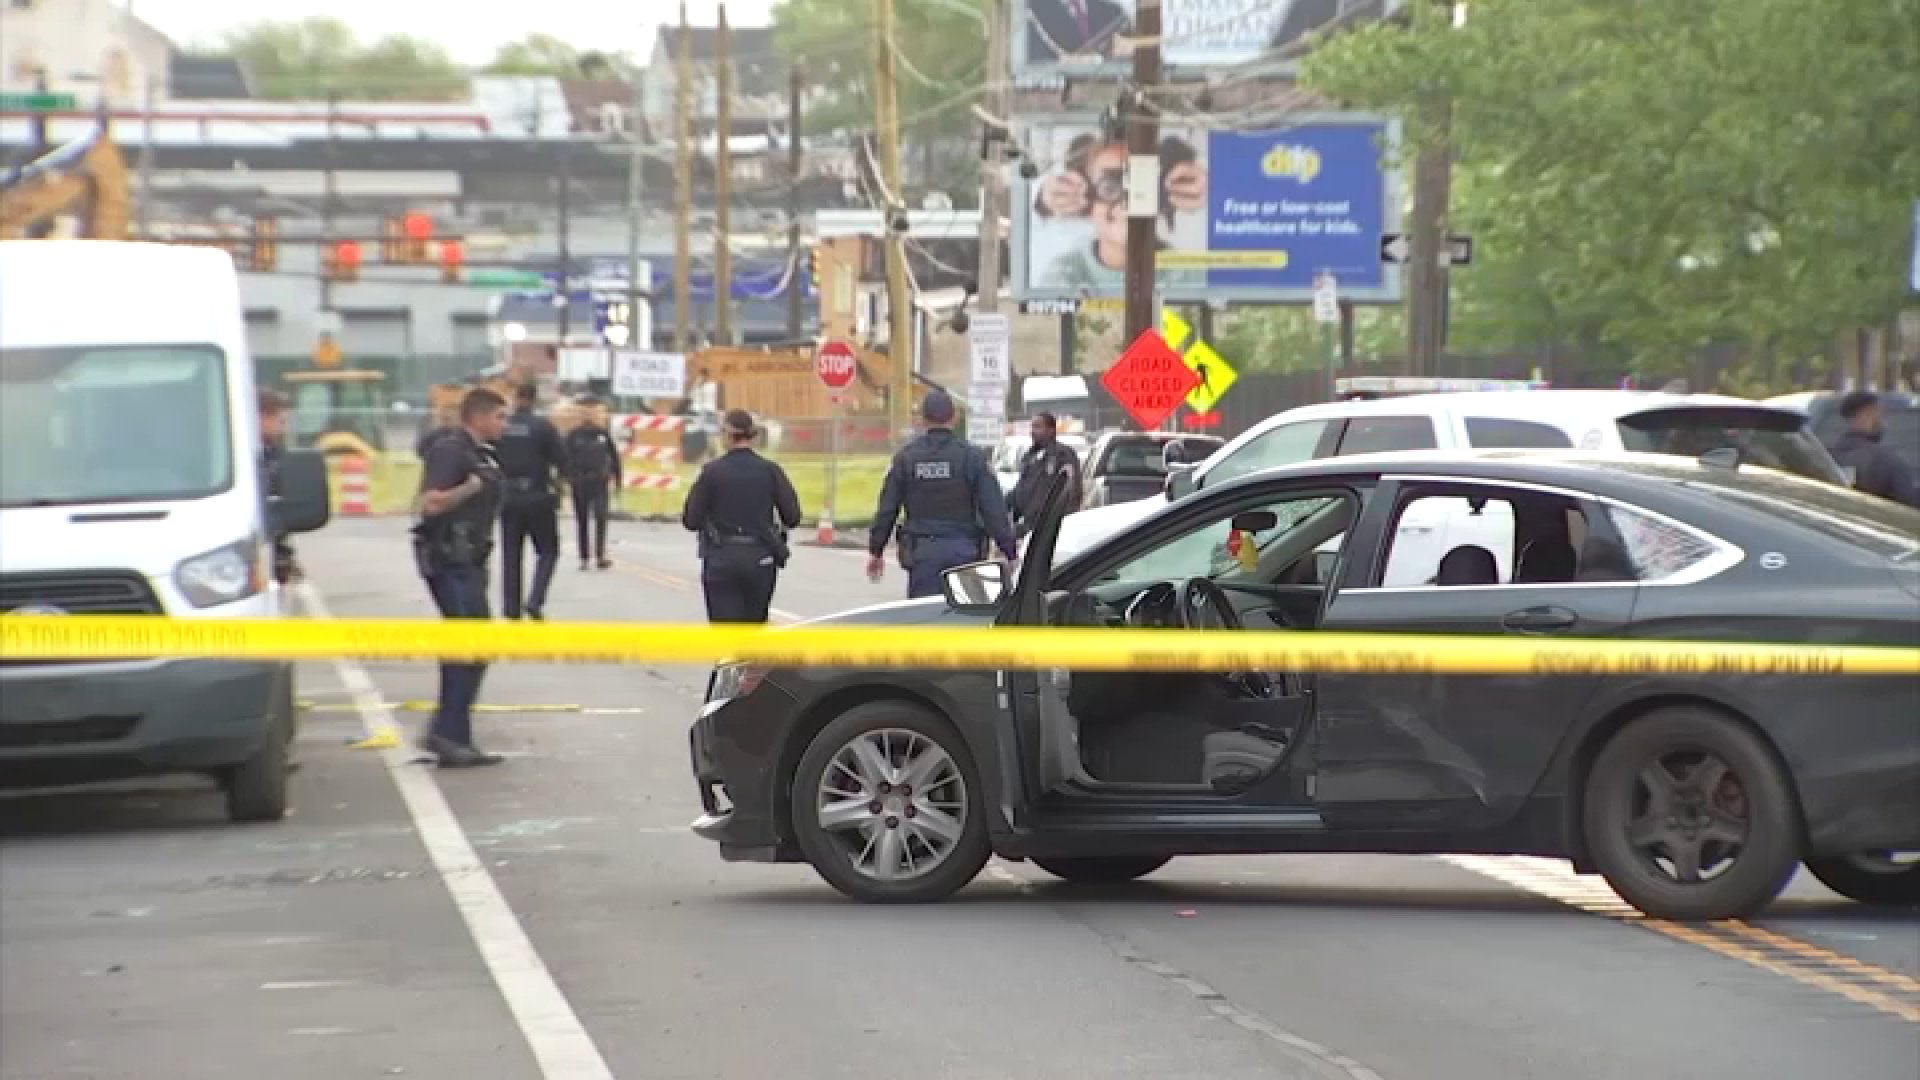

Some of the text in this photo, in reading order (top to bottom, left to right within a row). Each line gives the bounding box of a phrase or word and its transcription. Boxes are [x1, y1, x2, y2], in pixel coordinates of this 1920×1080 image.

[1223, 198, 1350, 215] Free or low-cost
[1215, 218, 1297, 235] healthcare
[1300, 218, 1322, 235] for
[630, 359, 670, 373] ROAD
[820, 356, 853, 375] STOP
[1130, 358, 1172, 373] ROAD
[621, 376, 677, 391] CLOSED
[1119, 377, 1182, 392] CLOSED
[1133, 395, 1174, 409] AHEAD
[916, 466, 950, 479] POLICE
